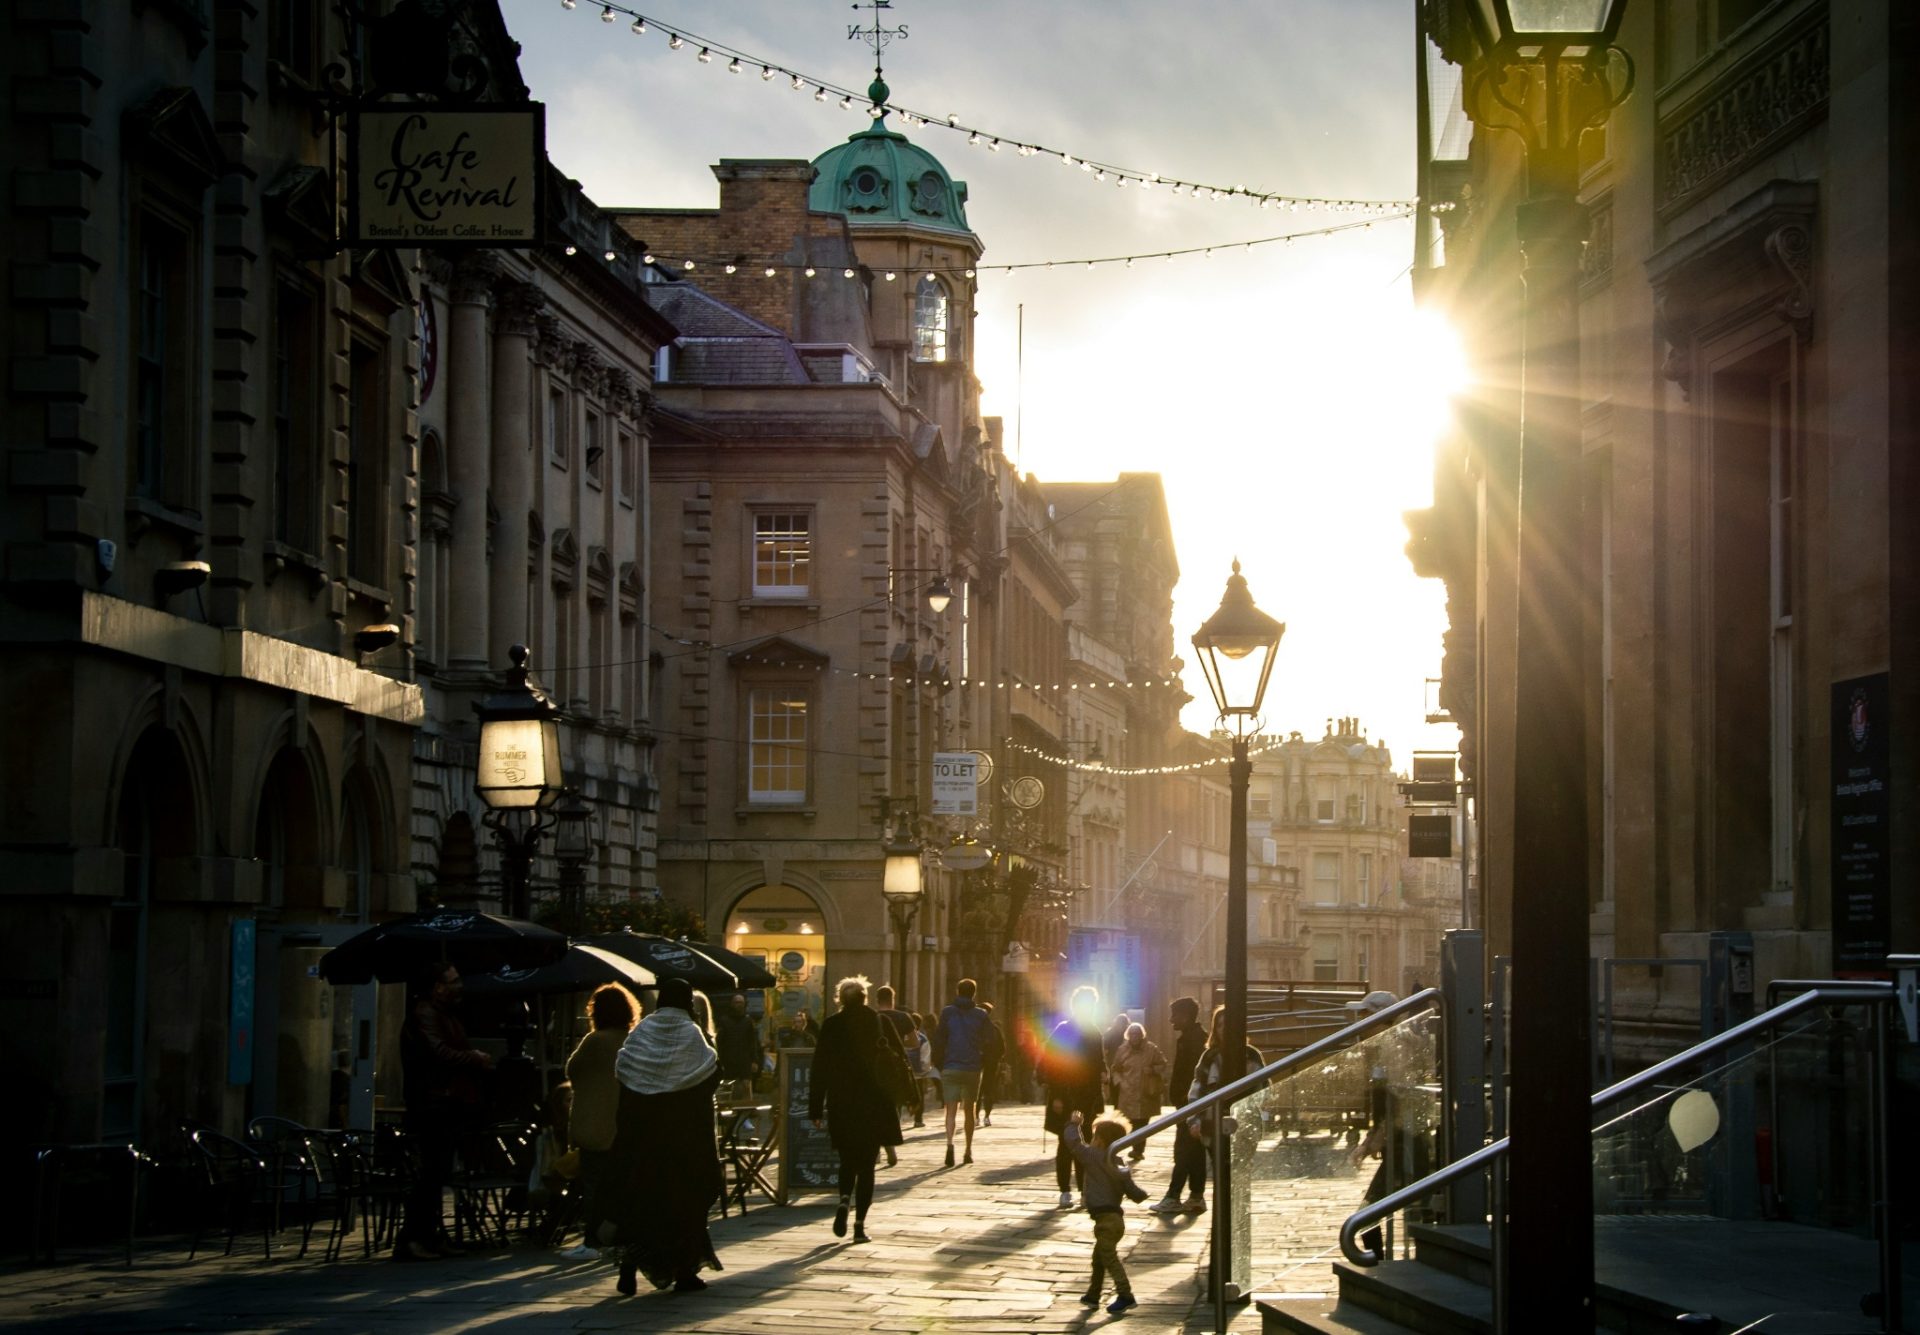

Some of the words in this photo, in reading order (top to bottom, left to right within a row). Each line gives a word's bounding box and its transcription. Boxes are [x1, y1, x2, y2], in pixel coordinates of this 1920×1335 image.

[898, 25, 908, 39] S
[391, 114, 480, 182] Cafe
[374, 168, 518, 221] Revival
[369, 224, 409, 238] Bristol's
[414, 223, 449, 237] Oldest
[453, 224, 487, 237] Coffee
[491, 224, 524, 236] House
[495, 752, 526, 760] RUMMER
[934, 765, 950, 777] TO
[953, 765, 974, 777] LET
